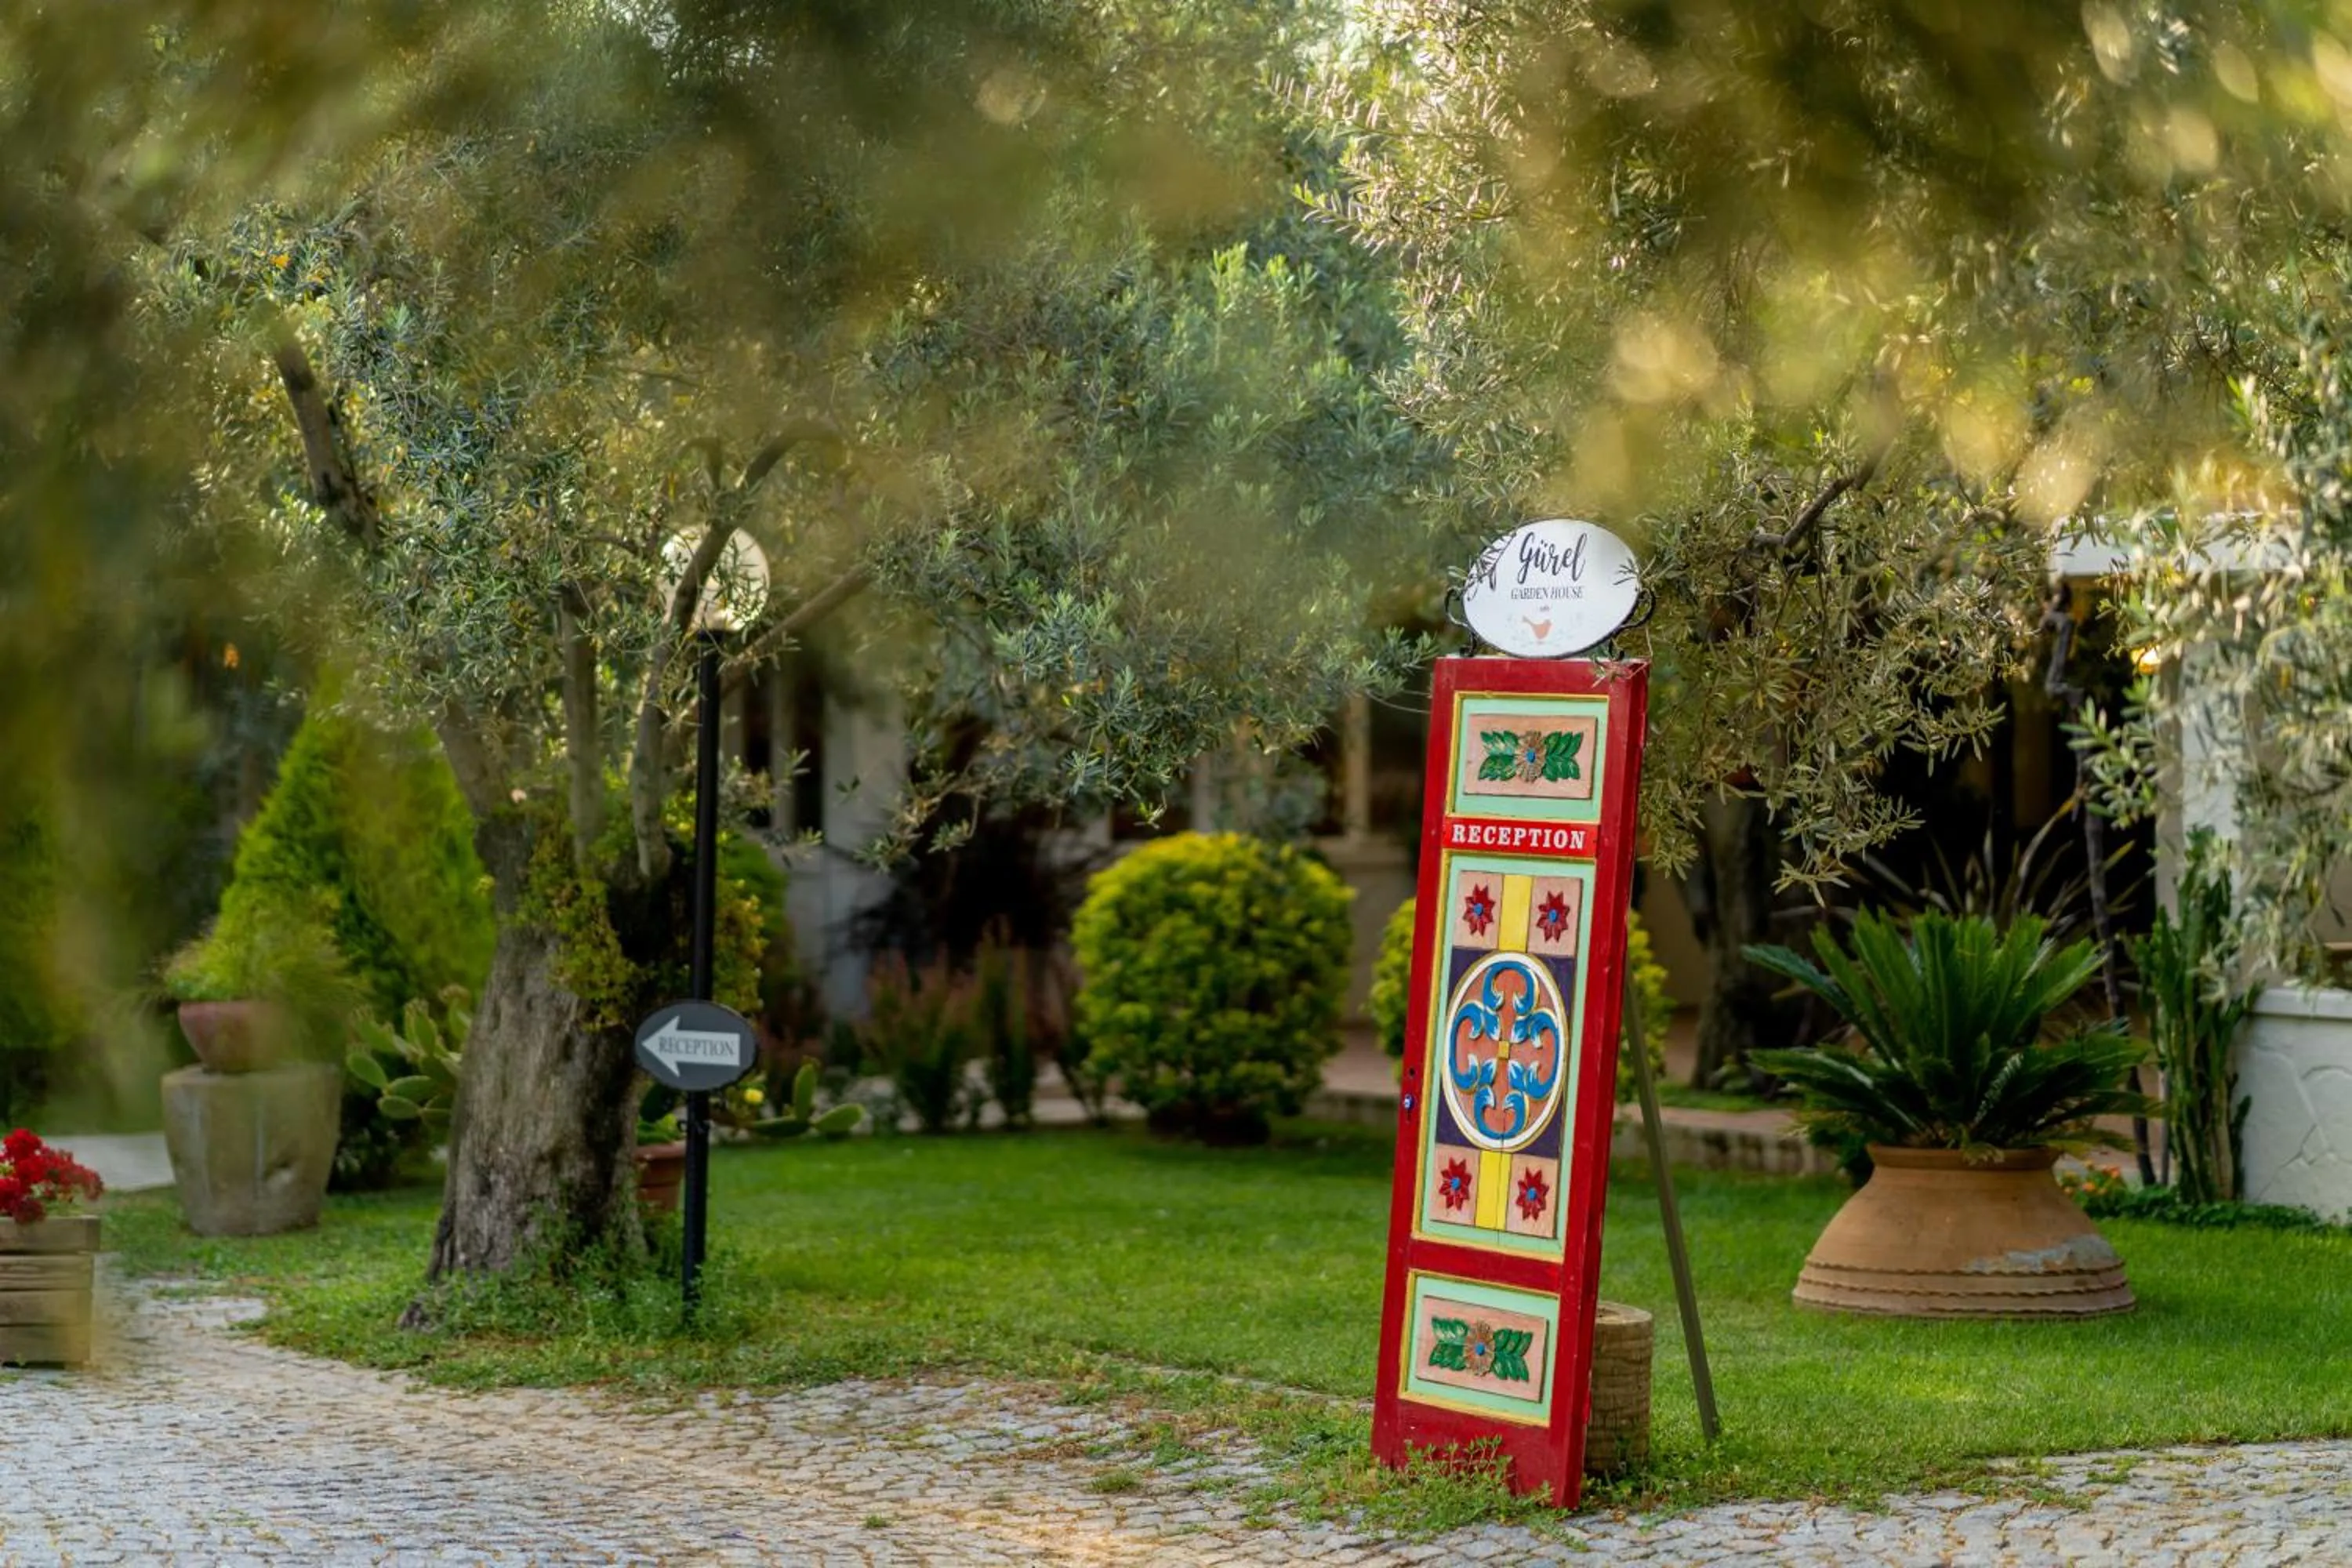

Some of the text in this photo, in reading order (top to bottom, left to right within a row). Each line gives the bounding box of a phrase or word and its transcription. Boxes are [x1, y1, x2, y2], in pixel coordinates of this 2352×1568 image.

[1517, 532, 1588, 584] Gürel
[1511, 586, 1584, 599] GARDEN HOUSE
[1452, 824, 1585, 849] RECEPTION
[659, 1036, 735, 1057] RECEPTION
